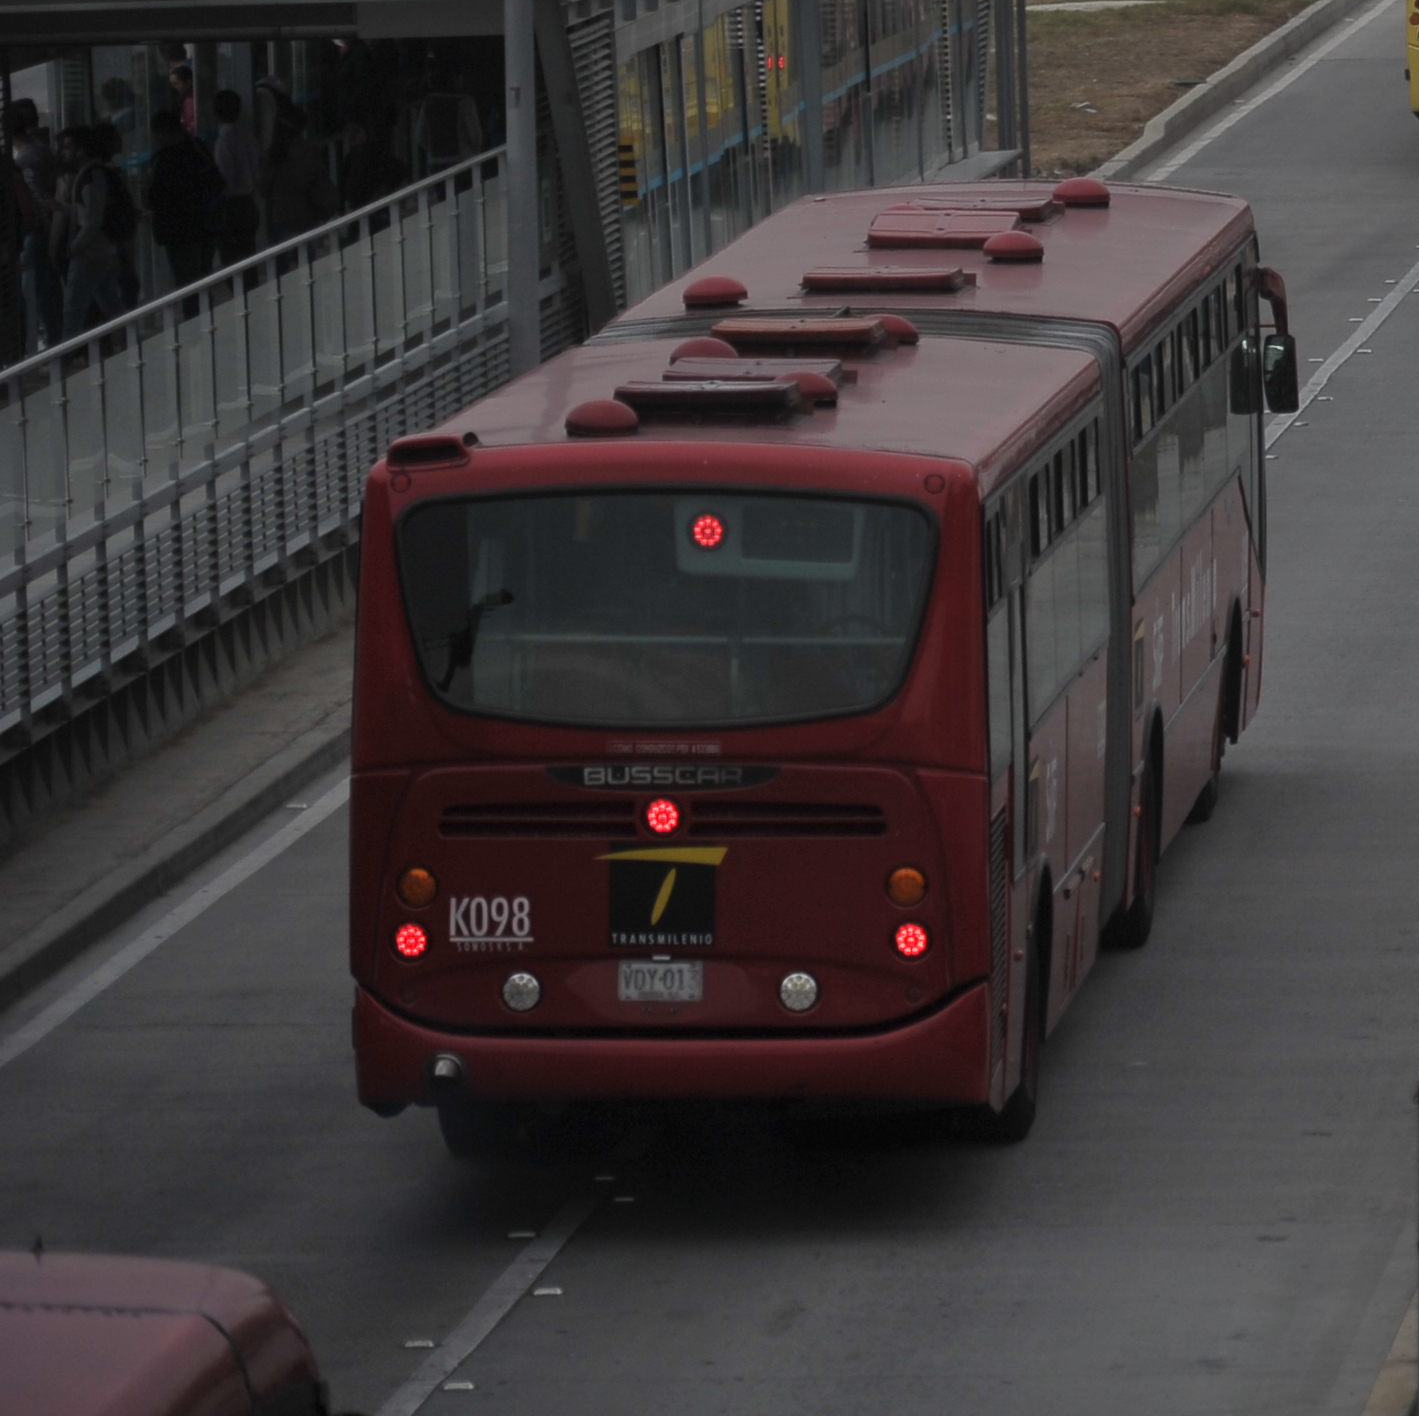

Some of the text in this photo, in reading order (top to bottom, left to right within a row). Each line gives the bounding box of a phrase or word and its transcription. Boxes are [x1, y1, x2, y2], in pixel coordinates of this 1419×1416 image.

[583, 766, 743, 786] BUSSCAR
[449, 896, 531, 937] K098
[612, 933, 714, 945] TRANSMILENIO
